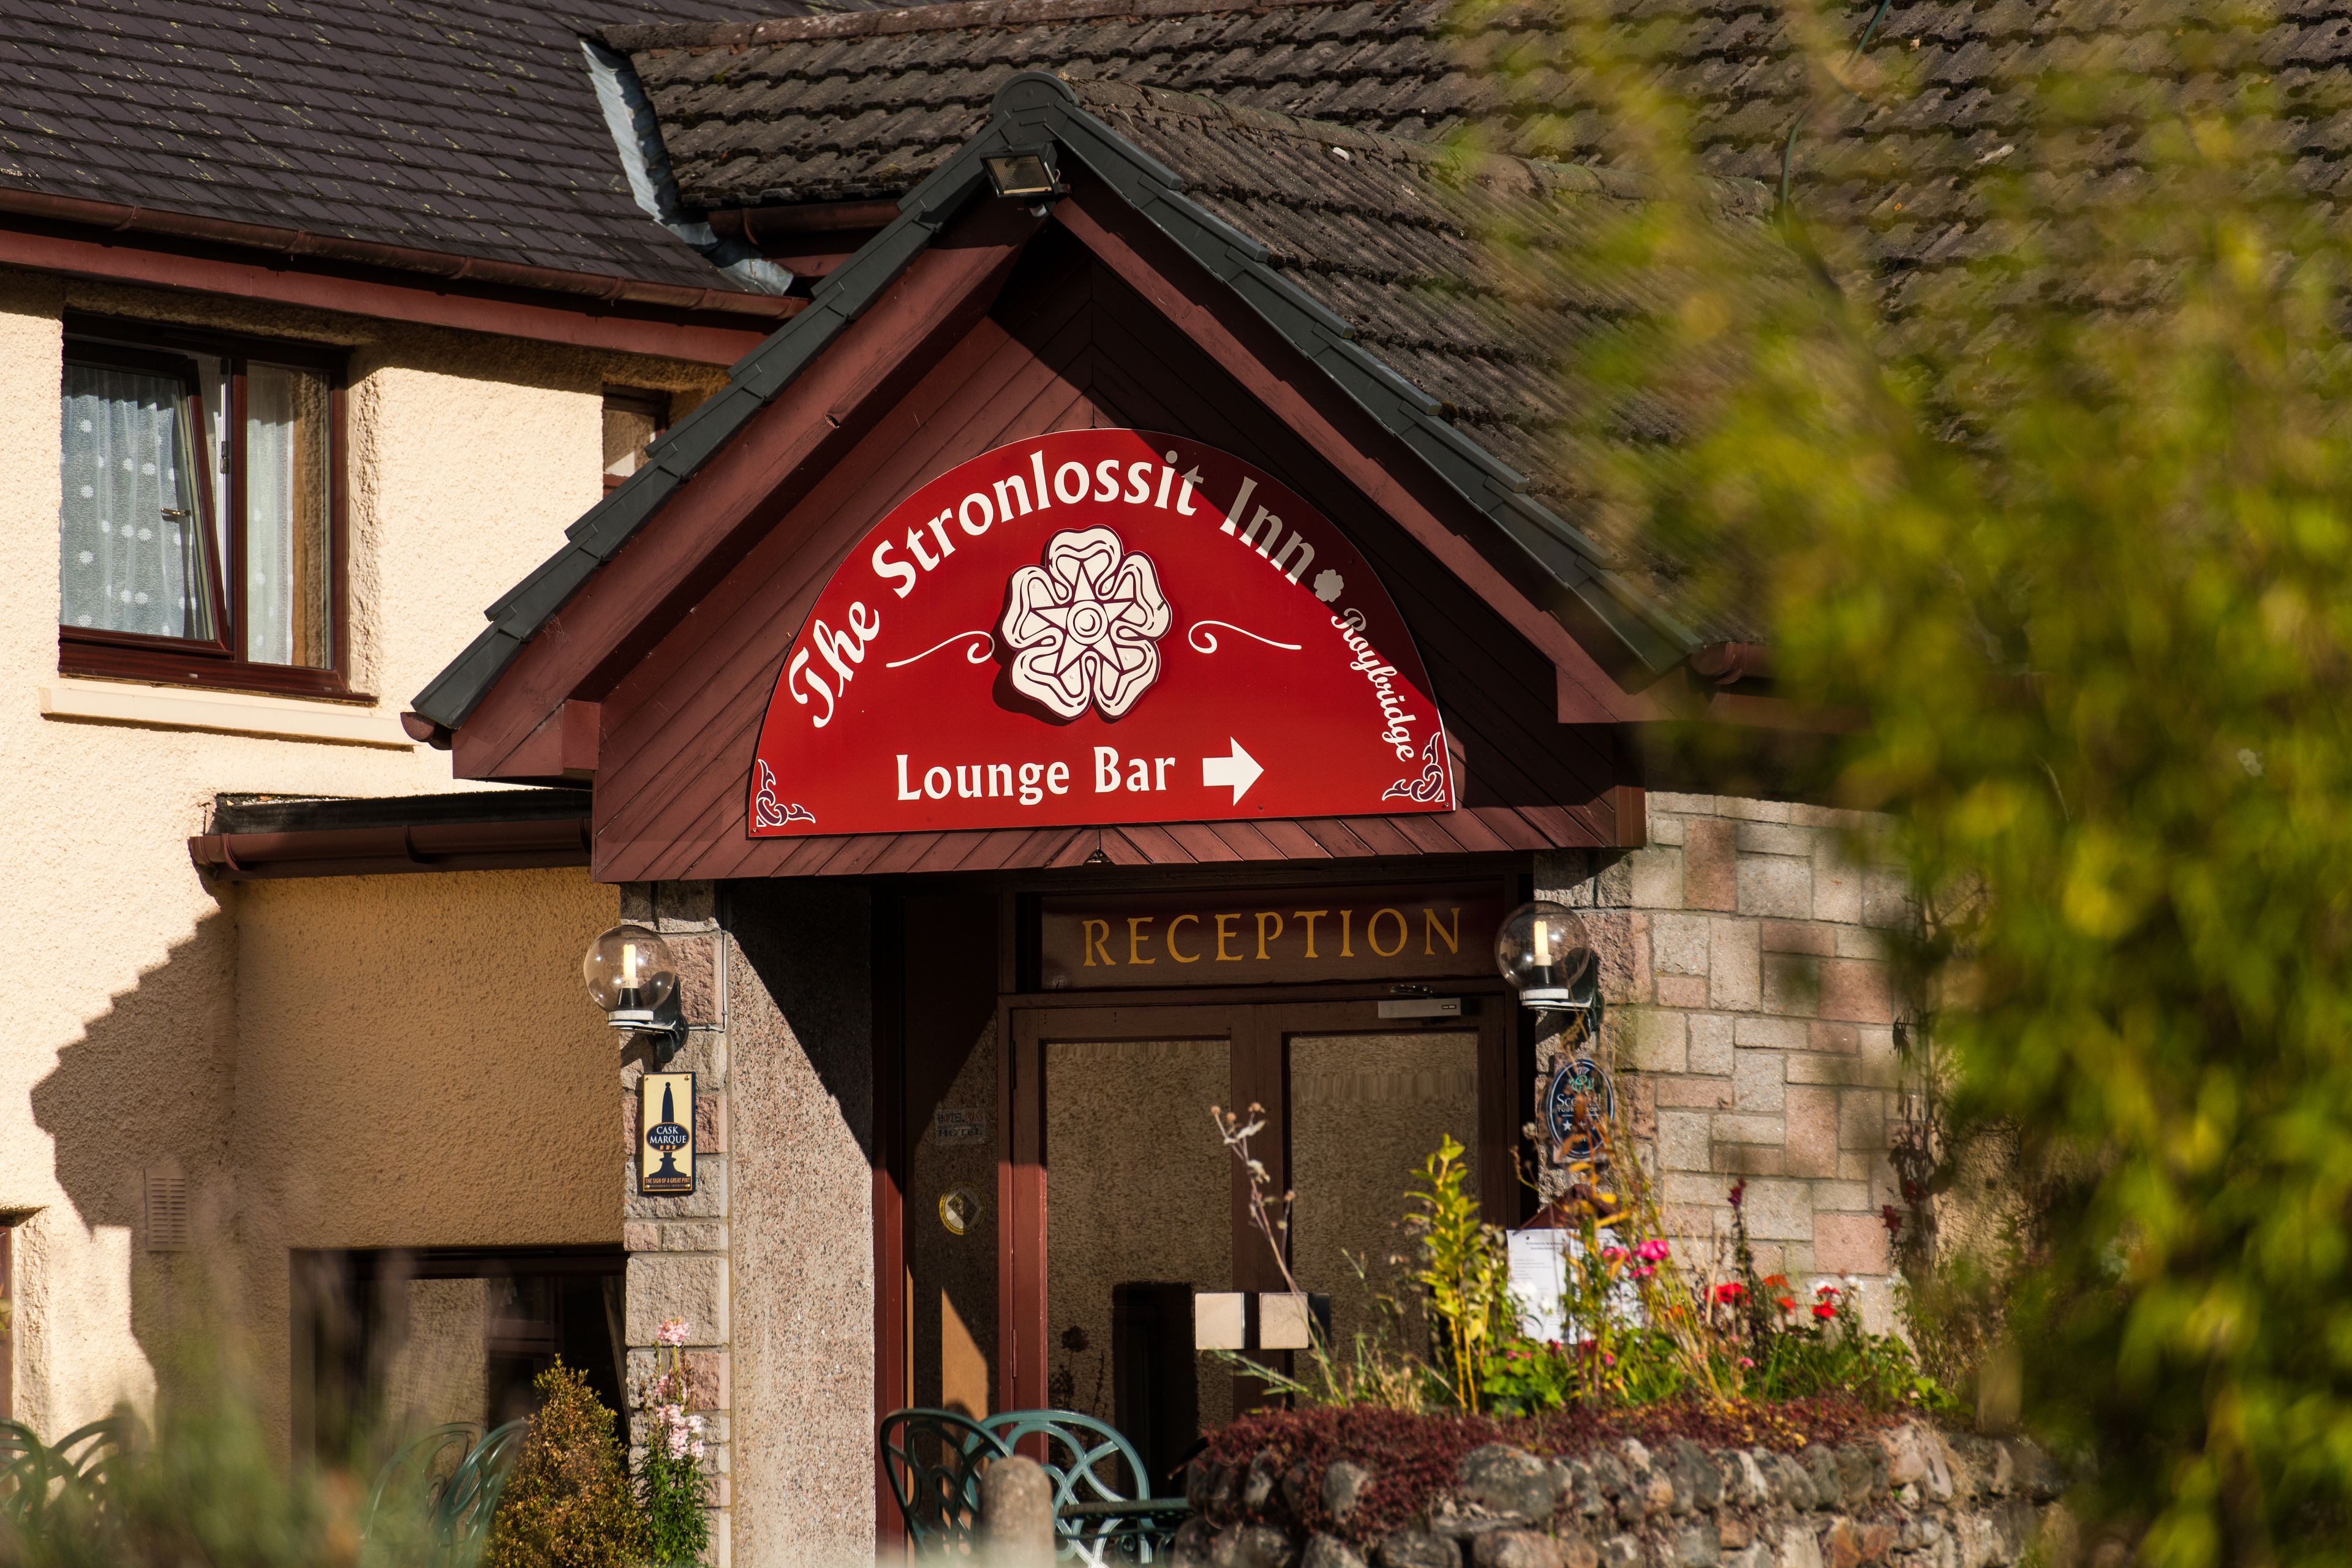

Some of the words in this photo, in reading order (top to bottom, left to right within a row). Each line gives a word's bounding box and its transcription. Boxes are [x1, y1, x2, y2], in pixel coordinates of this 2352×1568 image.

[789, 601, 880, 728] The
[872, 448, 1204, 598] Stronlossit
[1220, 477, 1315, 586] Inn
[1331, 608, 1416, 762] Roybridge
[897, 755, 1069, 805] Lounge
[1094, 747, 1175, 793] Bar
[1081, 908, 1461, 967] RECEPTION
[650, 1135, 686, 1144] MARQUE
[656, 1126, 678, 1134] CASK
